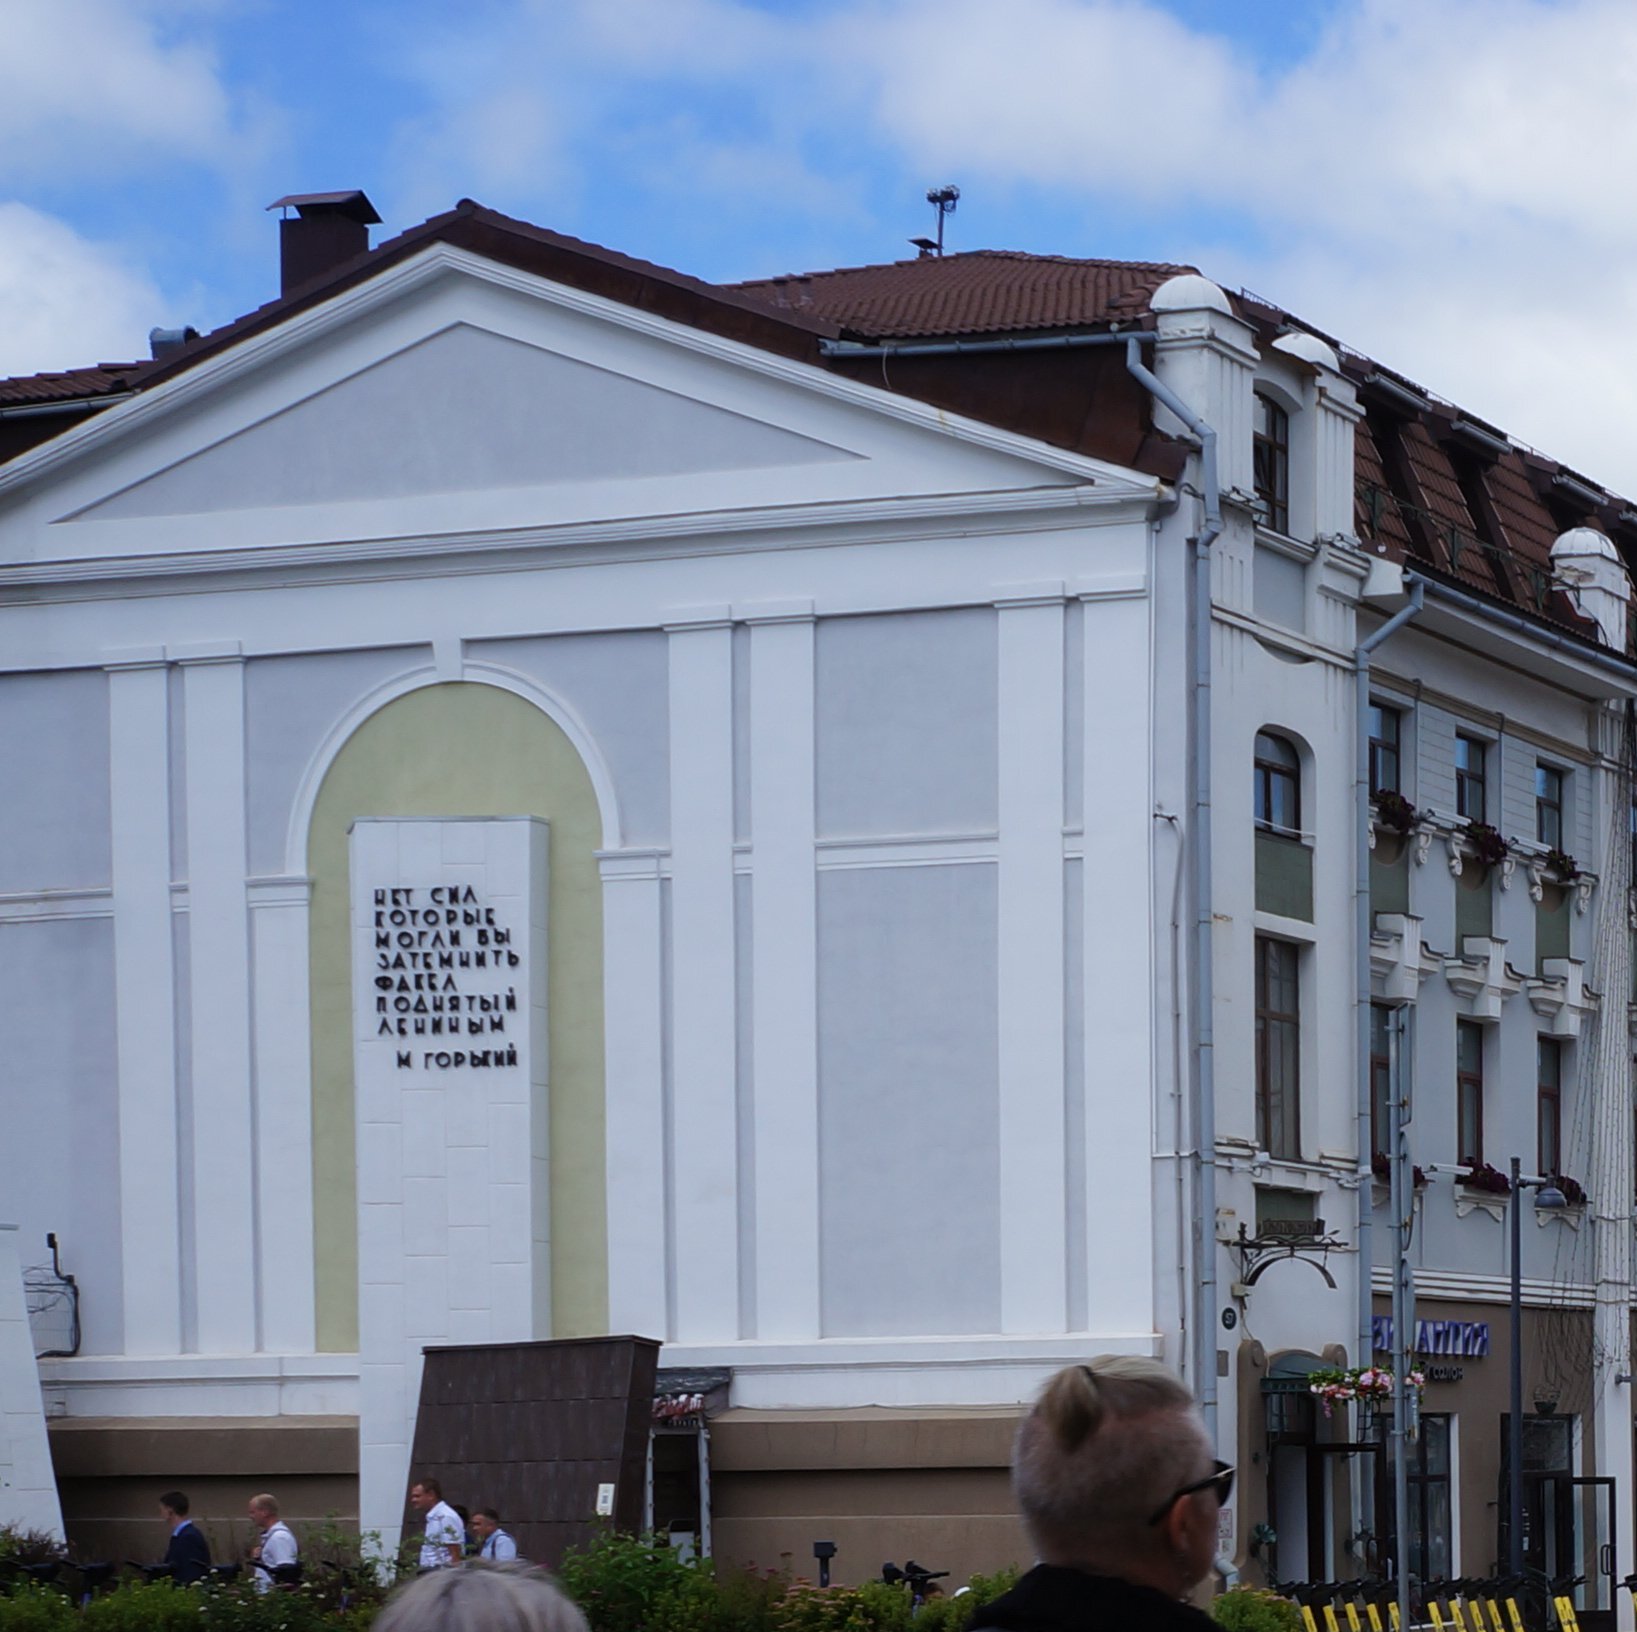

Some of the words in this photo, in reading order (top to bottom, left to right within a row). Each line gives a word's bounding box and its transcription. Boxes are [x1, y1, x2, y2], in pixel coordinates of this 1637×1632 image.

[374, 887, 413, 906] НЕТ
[430, 885, 478, 905] СИЛ
[375, 908, 495, 928] КОТОРЫЕ
[376, 929, 461, 949] МОГЛИ
[477, 928, 511, 946] БЫ
[376, 949, 520, 970] ЗАТЕМНИТЬ
[374, 973, 457, 992] ФАКЕЛ
[376, 987, 517, 1014] ПОДНЯТЫЙ
[378, 1015, 505, 1036] ЛЕНИНЫМ
[397, 1051, 411, 1068] М
[424, 1043, 518, 1069] ГОРЬКИЙ
